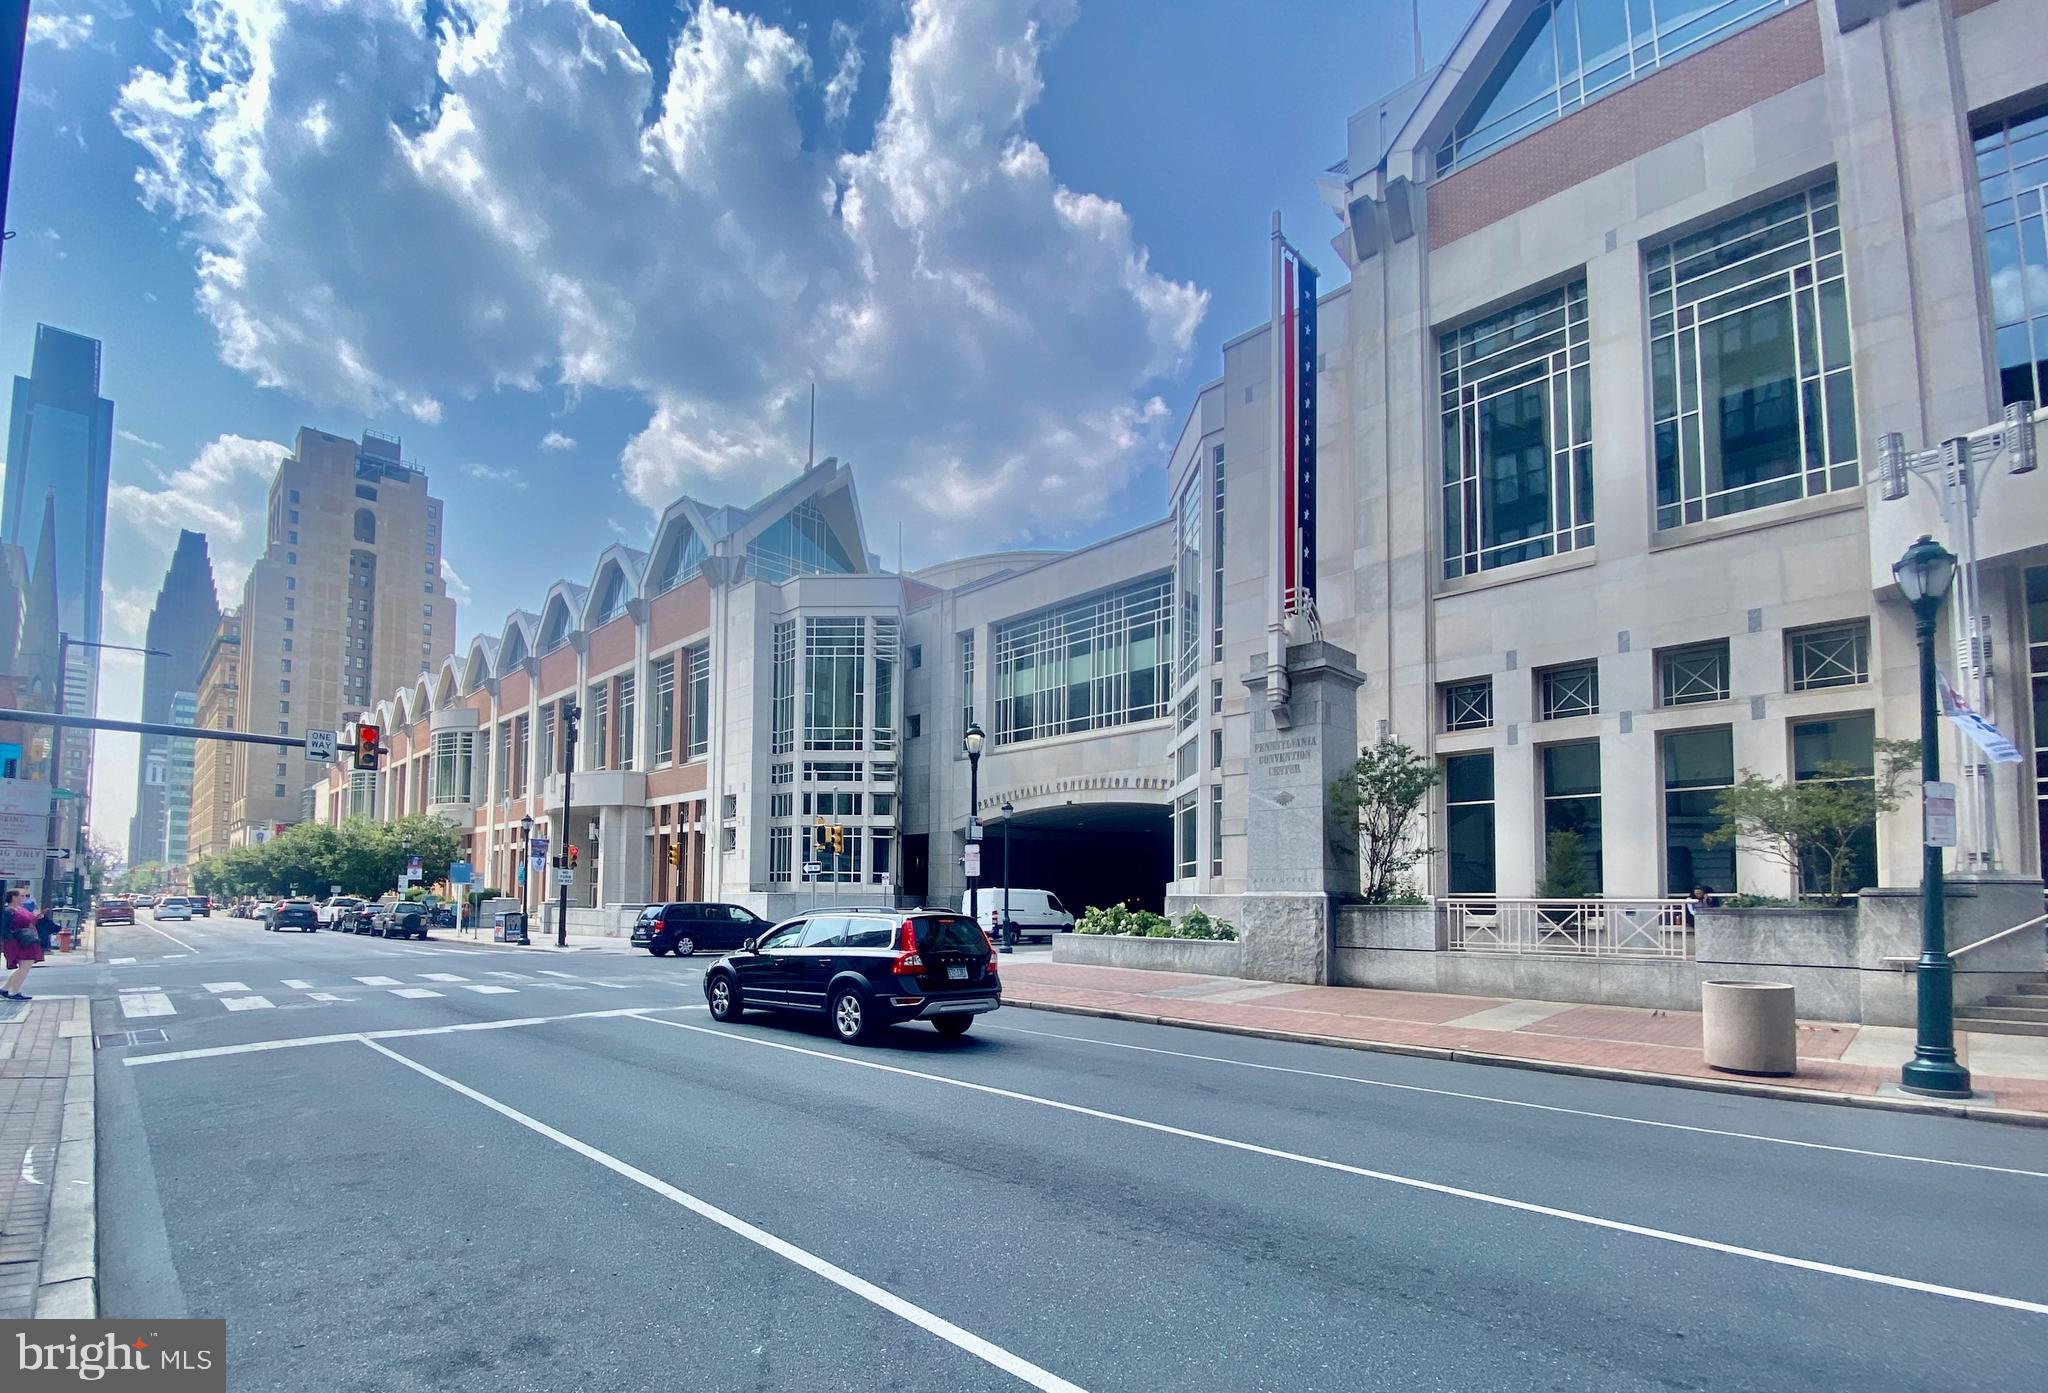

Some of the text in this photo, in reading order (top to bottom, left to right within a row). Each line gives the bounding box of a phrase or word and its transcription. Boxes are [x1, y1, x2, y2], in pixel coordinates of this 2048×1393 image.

[312, 732, 332, 741] ONE
[311, 740, 332, 749] WAY
[1254, 736, 1318, 753] PENNSYLVANIA
[1258, 749, 1312, 765] CONVENTION
[1268, 764, 1301, 777] CENTER
[977, 784, 1051, 811] PENNSYLVANIA
[1056, 777, 1129, 793] CONVENTION
[16, 850, 41, 858] ONLY
